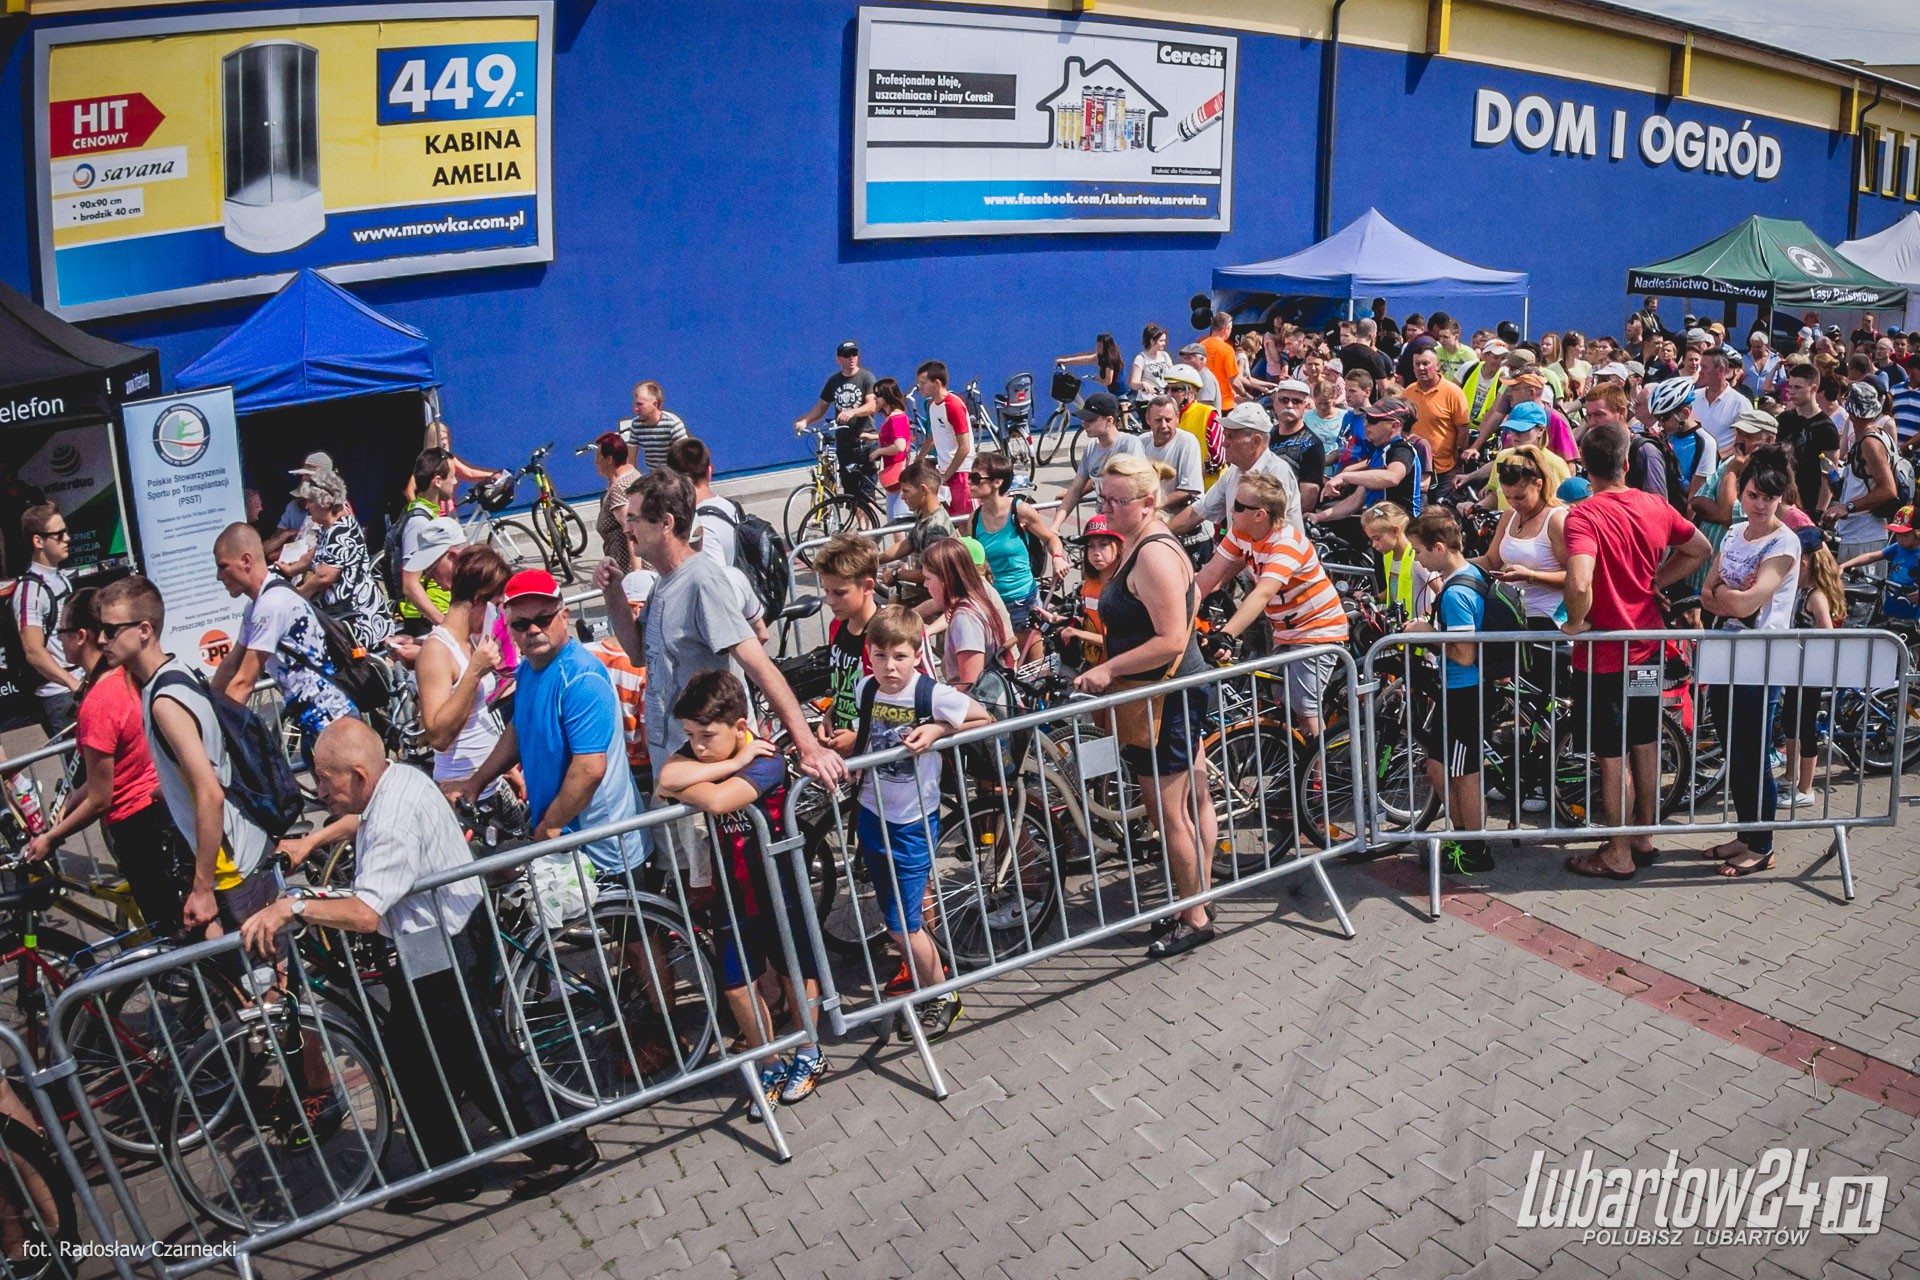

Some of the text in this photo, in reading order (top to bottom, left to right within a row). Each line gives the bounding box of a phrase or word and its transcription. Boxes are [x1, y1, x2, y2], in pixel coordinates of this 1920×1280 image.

[1159, 45, 1223, 67] Ceresit
[389, 53, 524, 113] 449,-
[876, 73, 962, 89] Profesjonalne kleje,
[875, 89, 994, 104] uszczelniacze i piany Ceresit
[73, 100, 128, 134] HIT
[874, 107, 895, 116] Jakość
[72, 133, 128, 149] CENOWY
[425, 129, 521, 155] KABINA
[1473, 88, 1782, 180] DOM I OGRÓD
[101, 161, 175, 182] savana
[432, 161, 521, 187] AMELIA
[80, 198, 122, 209] 90x90 cm
[983, 192, 1207, 207] www.facebook.com/Lubartow.mrowka
[80, 206, 141, 221] brodzik 40 cm
[353, 210, 525, 242] www.mrowka.com.pl
[1634, 276, 1768, 299] Nadleśnictwo Lubartów
[1810, 287, 1832, 303] Lasy
[147, 467, 226, 488] Polskie Stowarzyszenie
[147, 478, 230, 501] Sportu po Transplantacji
[179, 495, 202, 508] (PSST)
[214, 615, 230, 623] nowe
